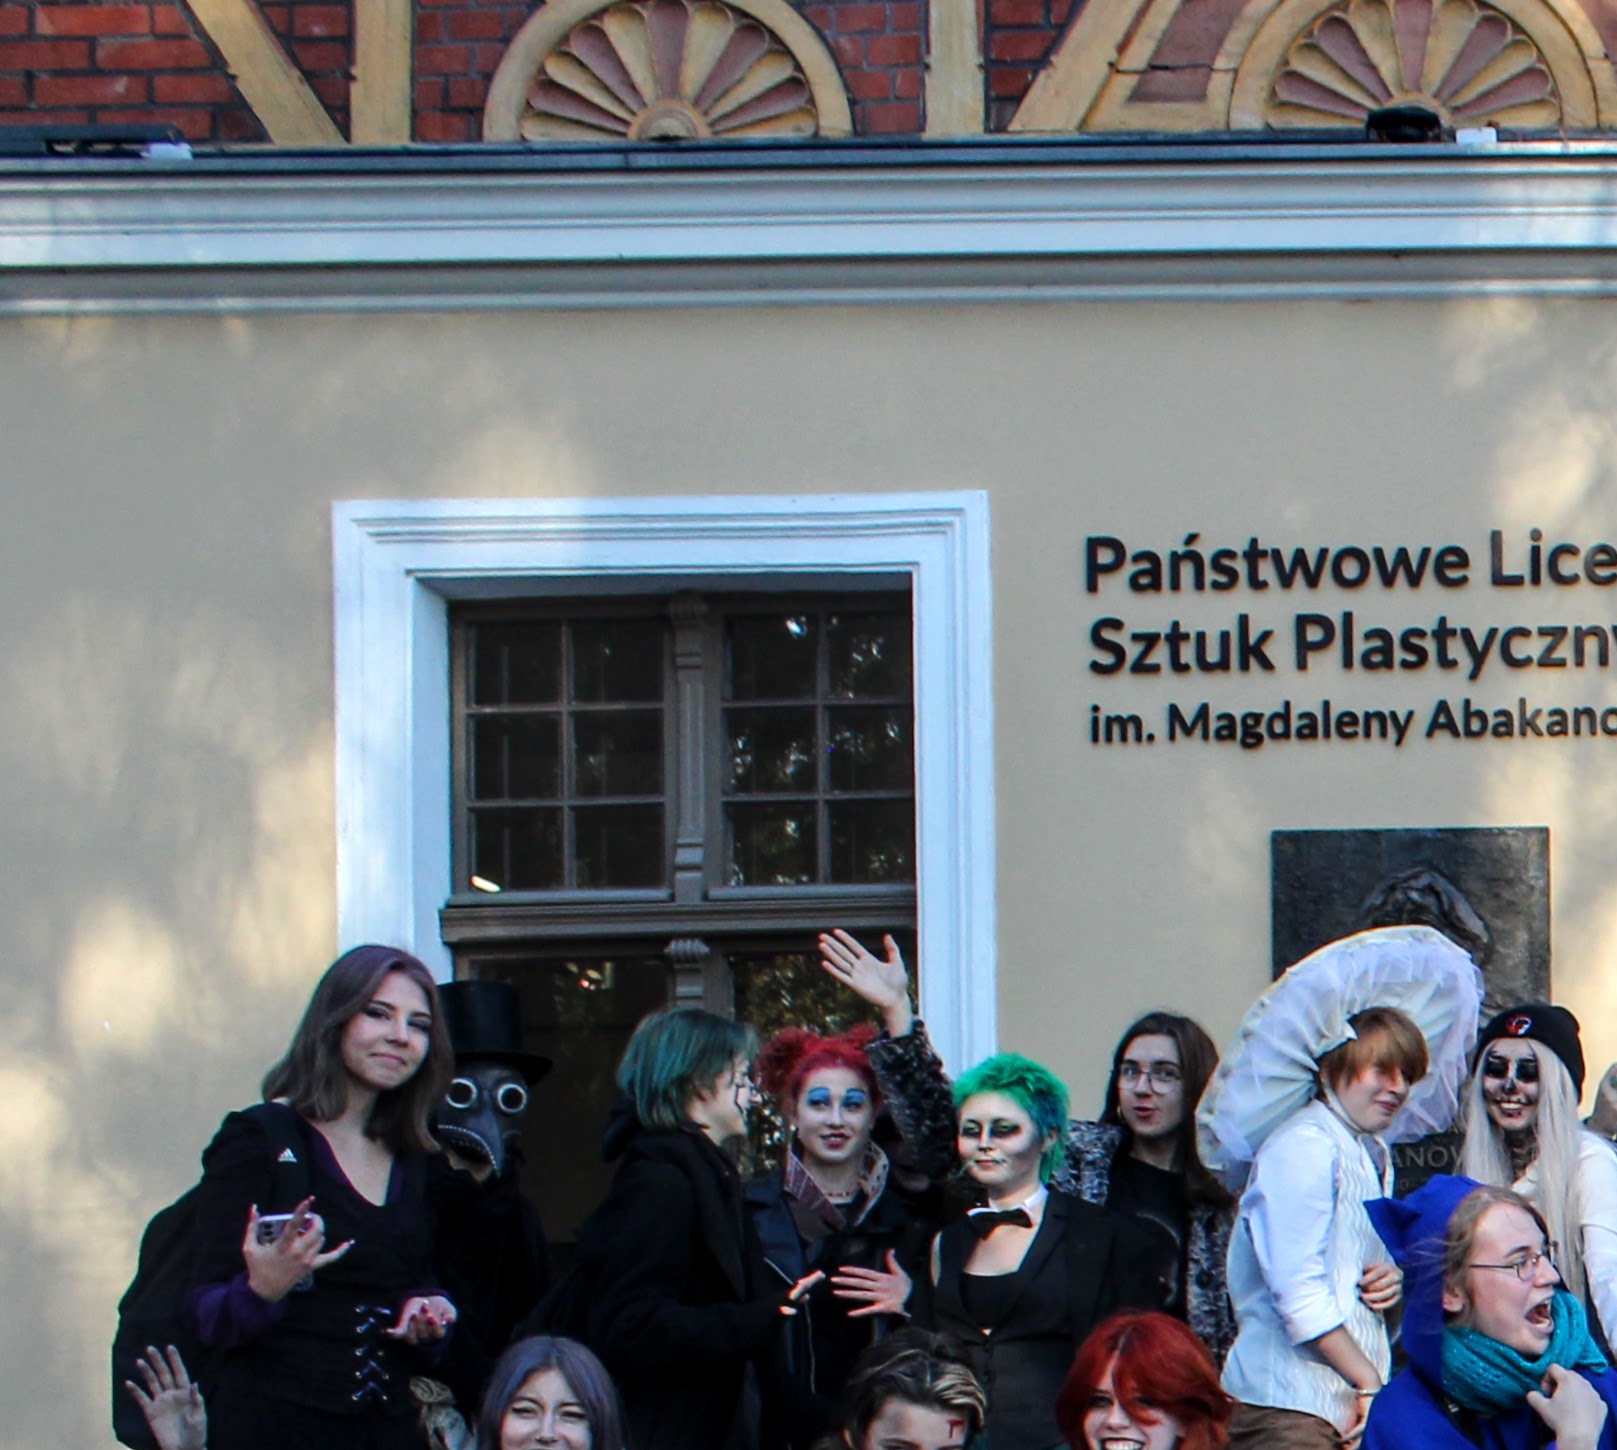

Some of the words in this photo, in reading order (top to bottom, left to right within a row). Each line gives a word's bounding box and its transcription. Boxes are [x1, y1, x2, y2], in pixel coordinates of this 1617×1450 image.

[1085, 533, 1470, 594] Państwowe
[1089, 613, 1275, 675] Sztuk
[1090, 704, 1155, 743] im.
[1168, 700, 1415, 750] Magdaleny
